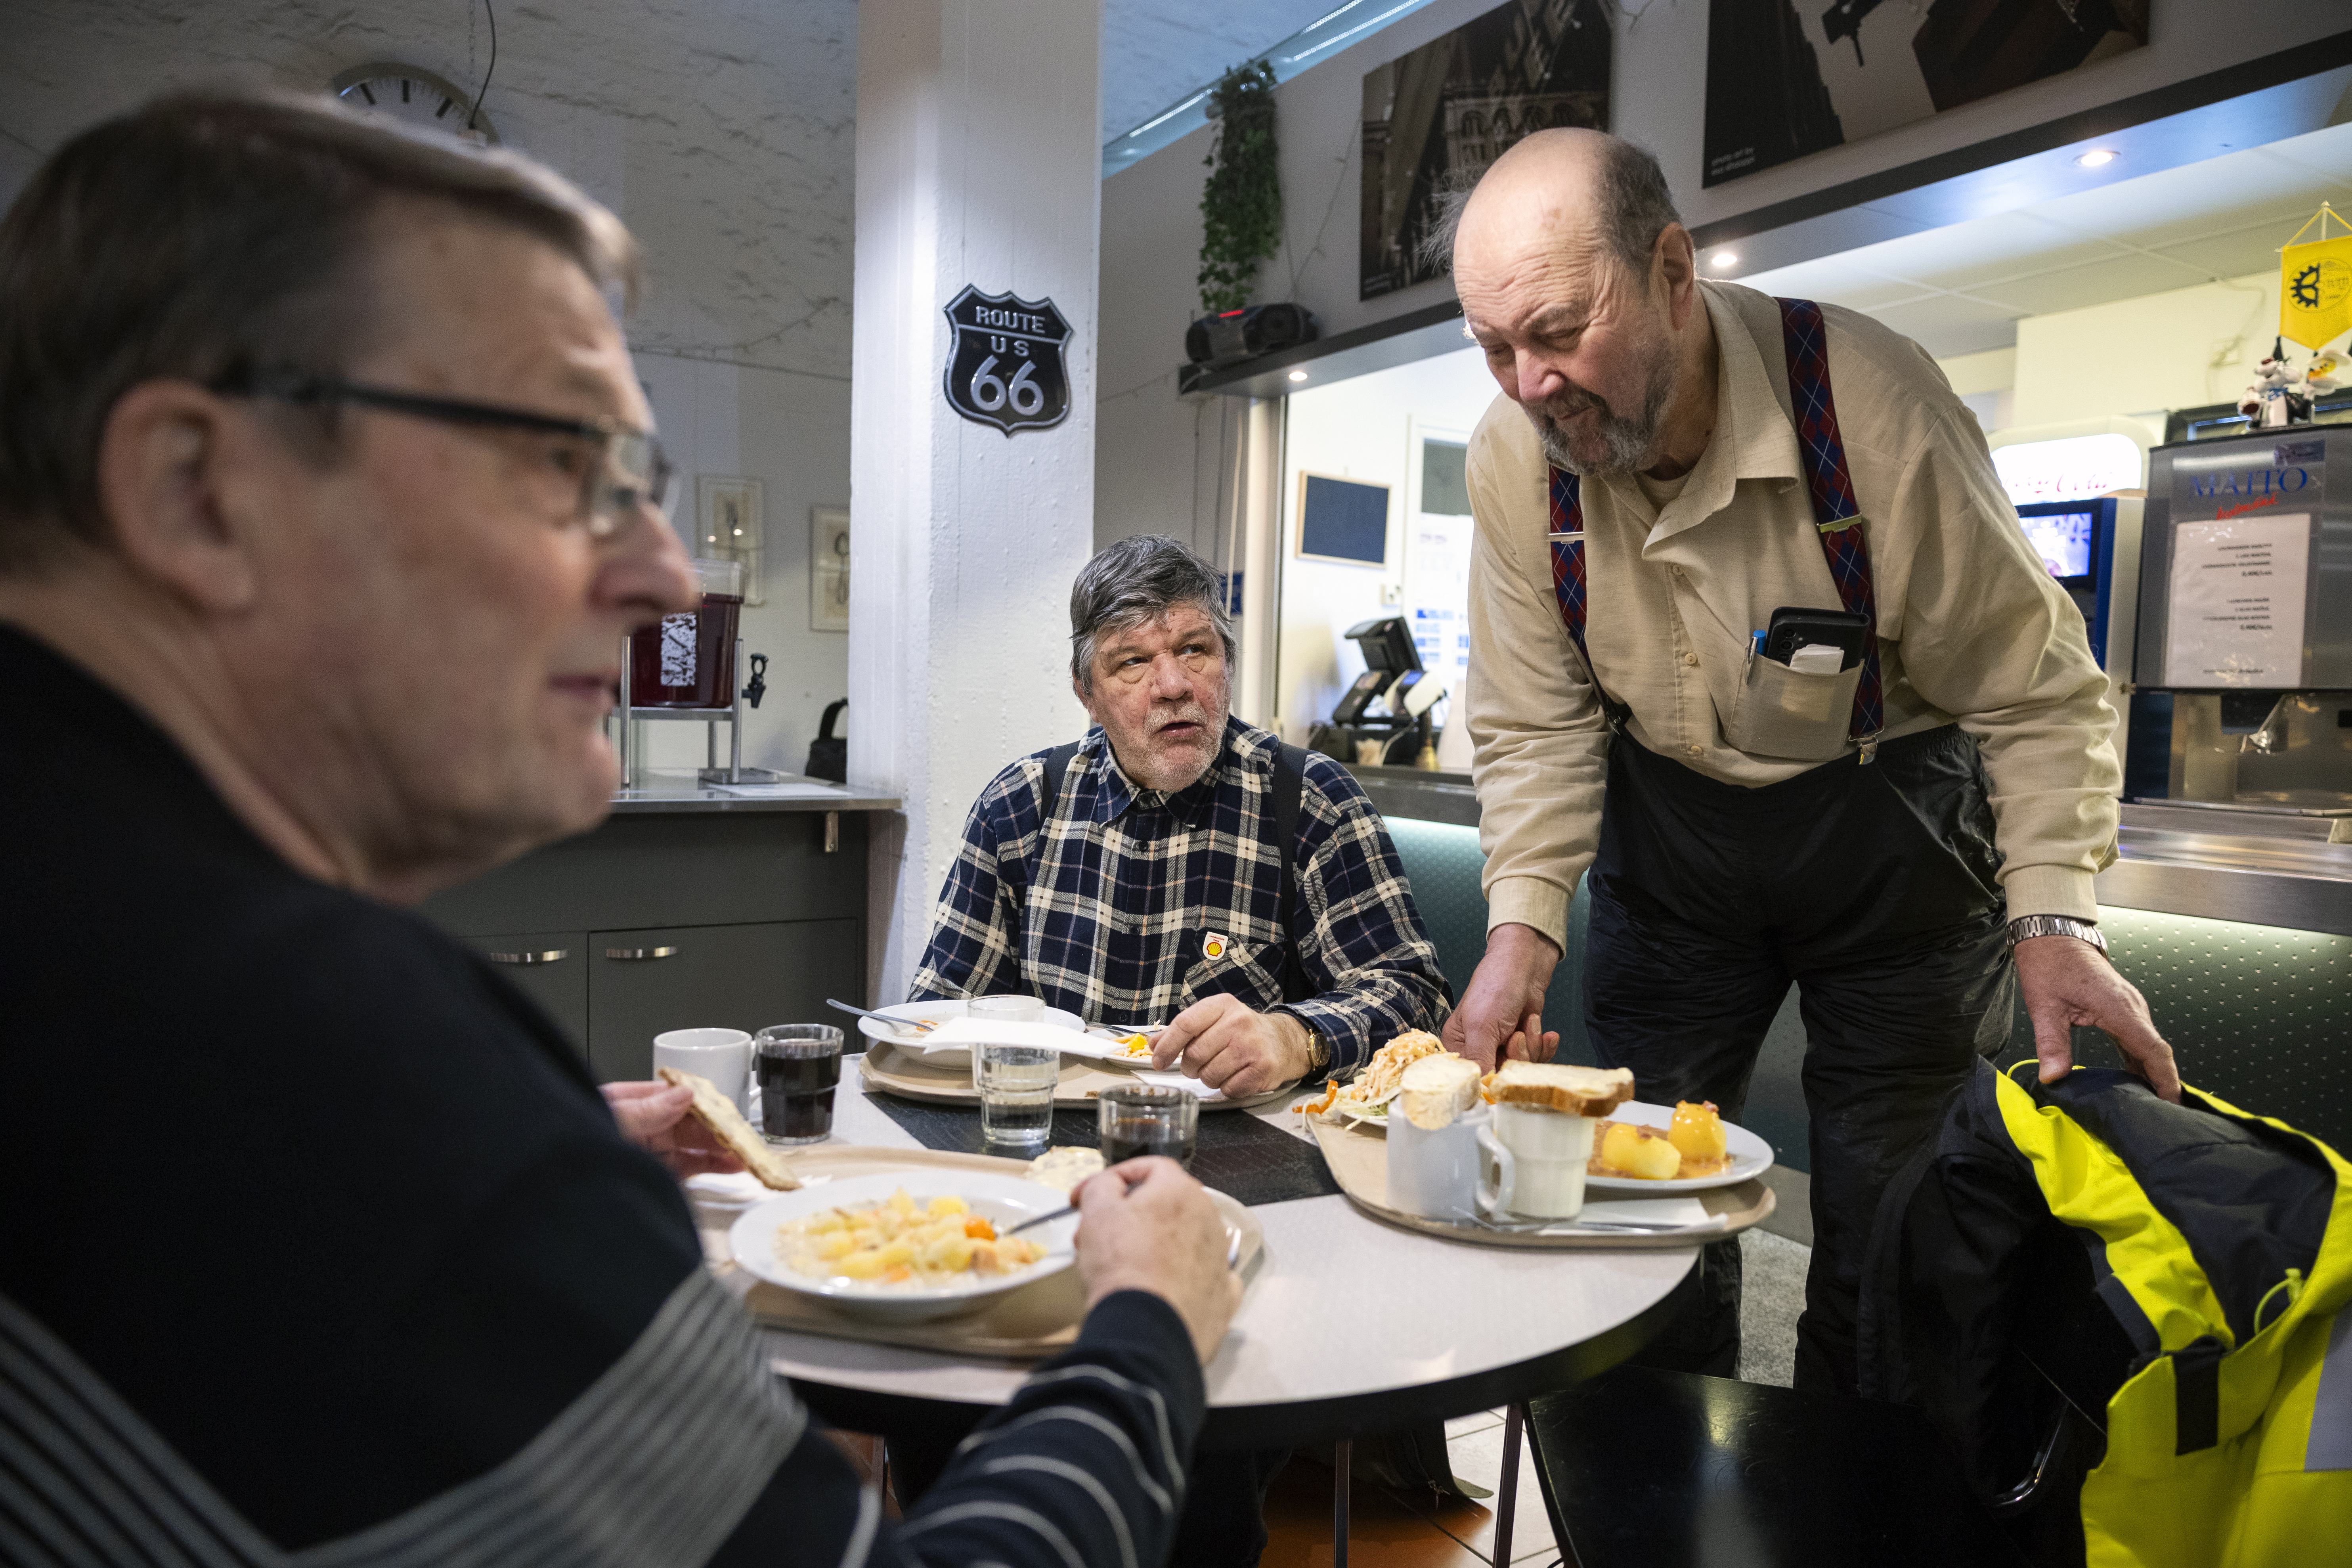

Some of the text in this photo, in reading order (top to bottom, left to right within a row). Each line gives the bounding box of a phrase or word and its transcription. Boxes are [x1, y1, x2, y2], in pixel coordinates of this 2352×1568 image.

[976, 306, 1046, 333] ROUTE
[970, 355, 1044, 416] 66
[2189, 468, 2308, 499] MAITO
